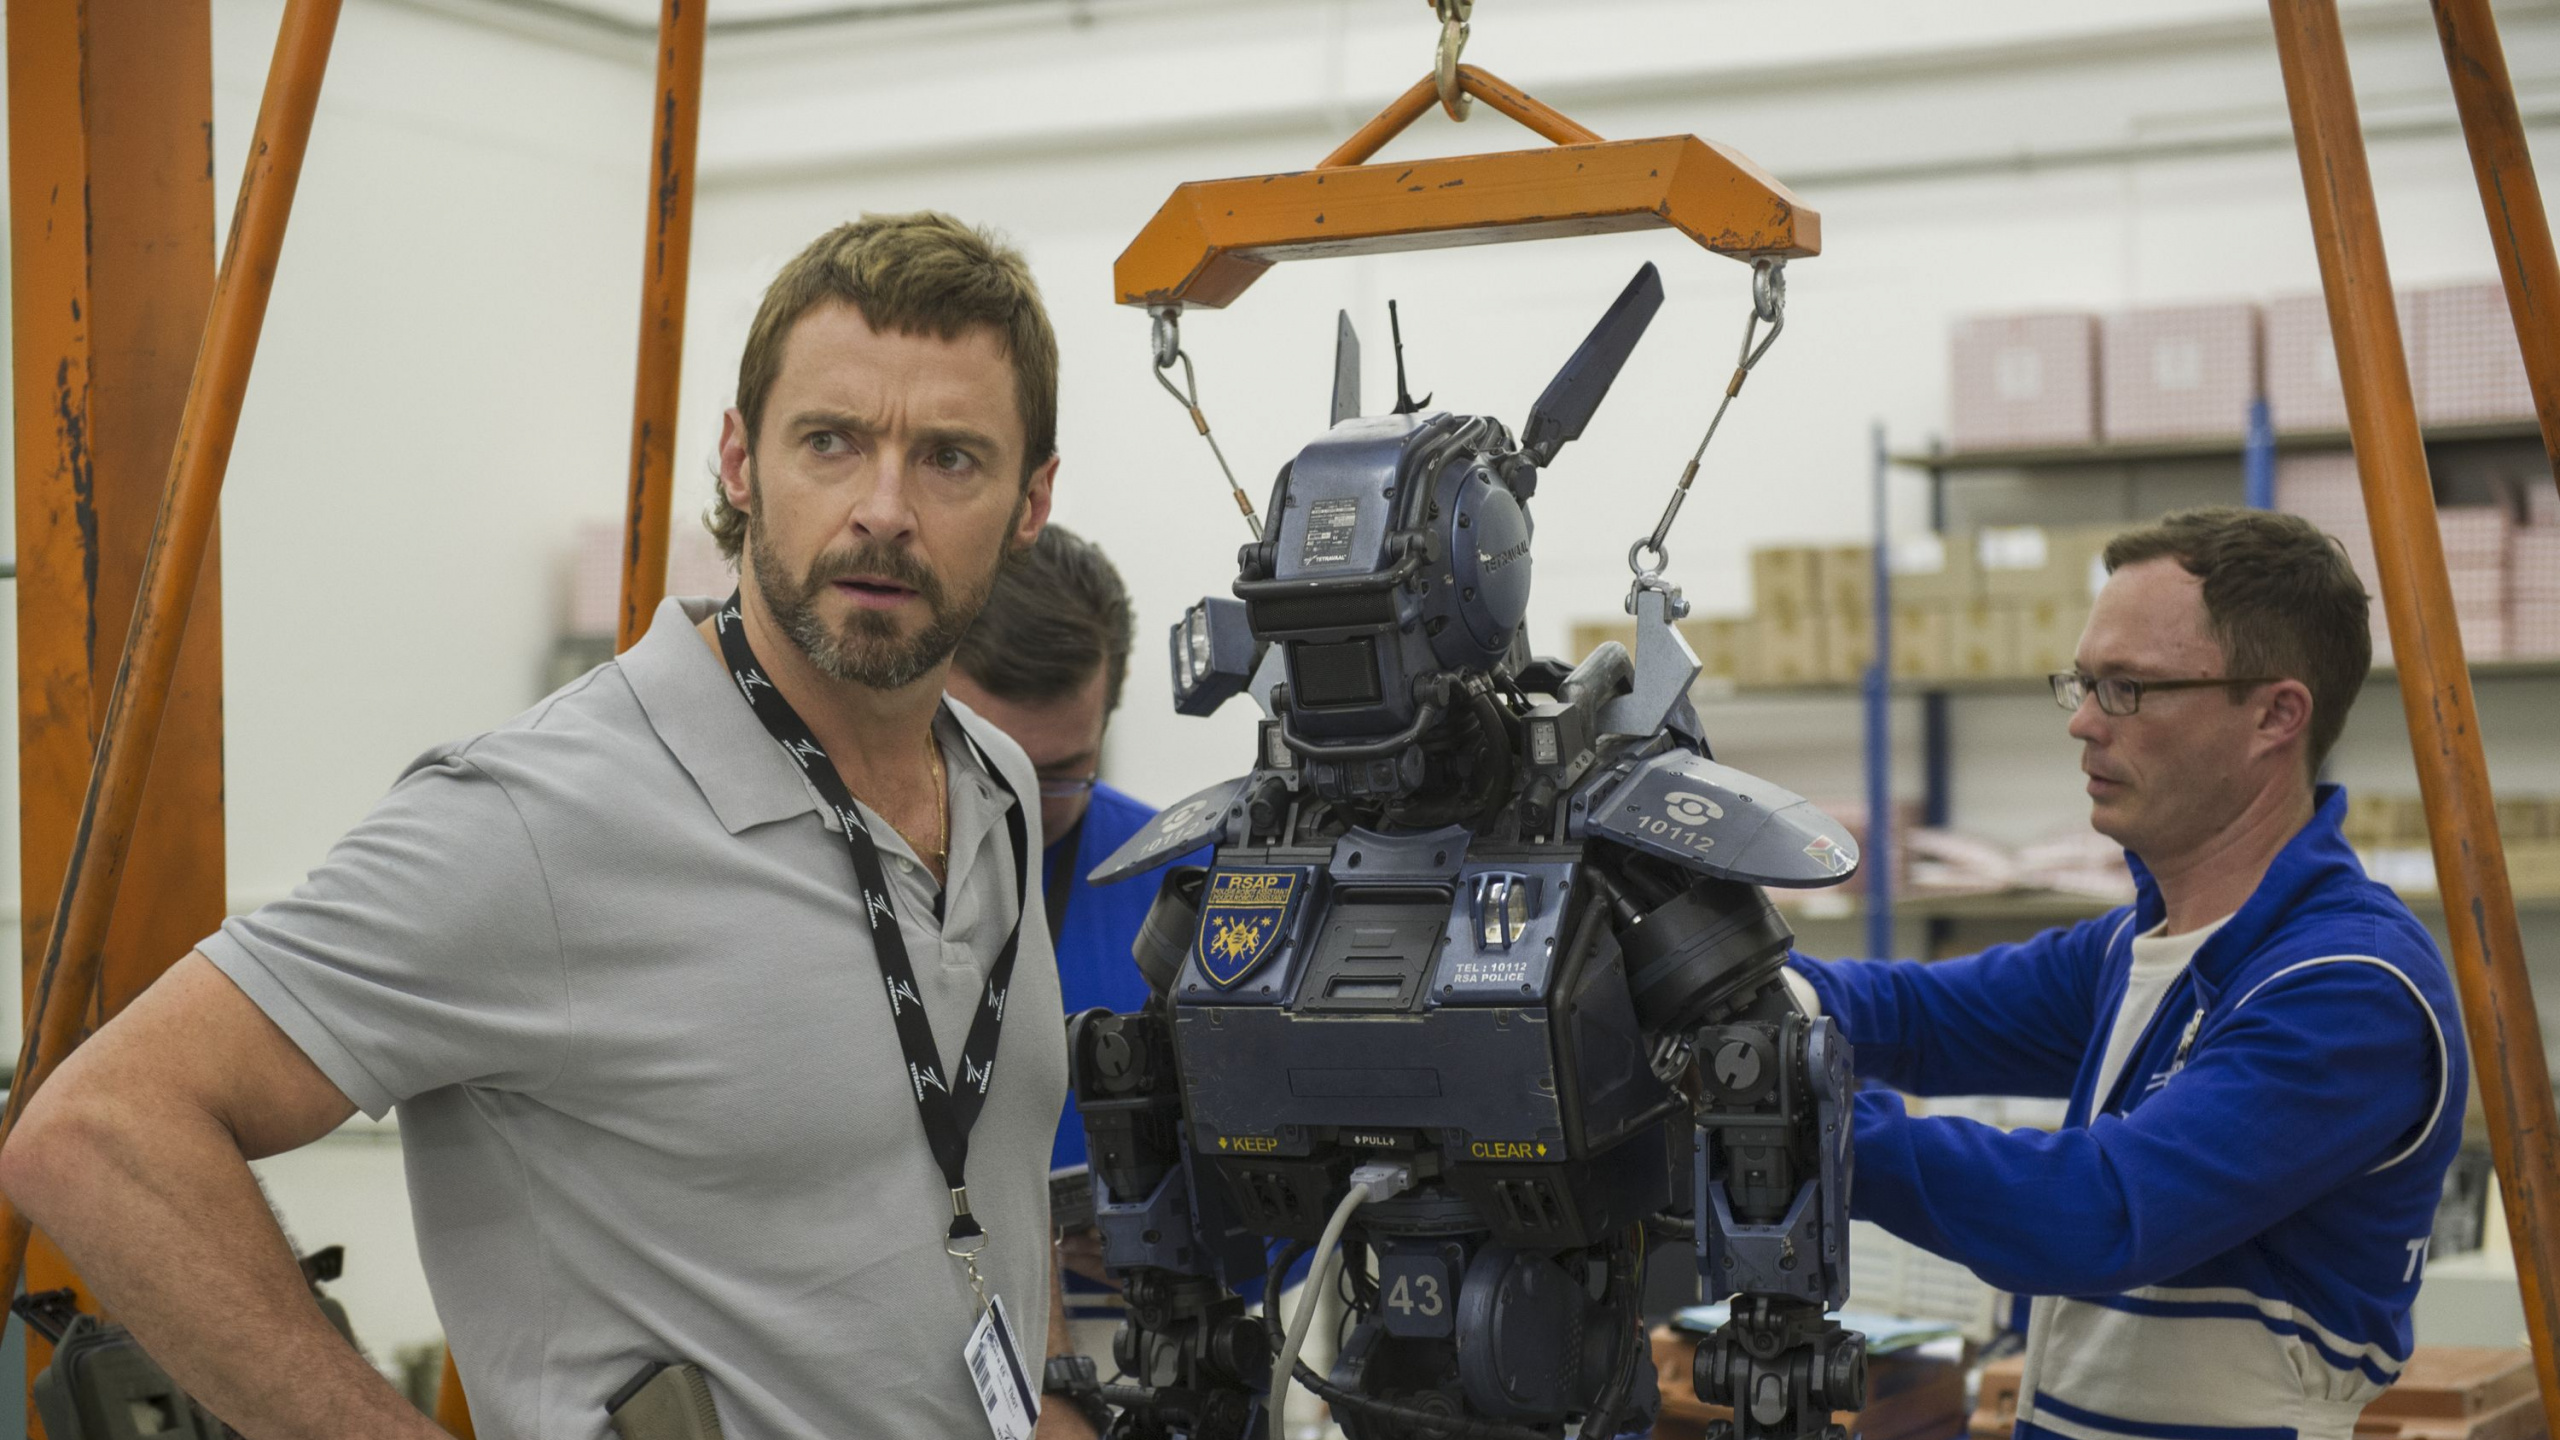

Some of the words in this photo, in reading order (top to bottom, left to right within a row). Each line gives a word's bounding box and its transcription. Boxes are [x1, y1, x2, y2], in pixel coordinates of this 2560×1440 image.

[735, 669, 755, 705] TETRAVAAL
[782, 739, 809, 769] TETRAVAAL
[834, 805, 854, 842] TETRAVAAL
[1139, 822, 1200, 856] 10112
[1637, 816, 1715, 853] 10112
[1228, 876, 1279, 889] RSAP
[863, 889, 878, 929] TETRAVAAL
[1454, 973, 1478, 983] RSA
[1481, 973, 1525, 982] POLICE
[1456, 963, 1479, 973] TEL
[1491, 962, 1528, 972] 10112
[886, 975, 901, 1017] TETRAVAAL
[910, 1062, 925, 1102] TETRAVAAL
[979, 1060, 992, 1094] TETRAVAAL
[1232, 1137, 1278, 1152] KEEP
[1362, 1136, 1389, 1146] PULL
[1471, 1142, 1534, 1158] CLEAR
[1387, 1274, 1443, 1316] 43
